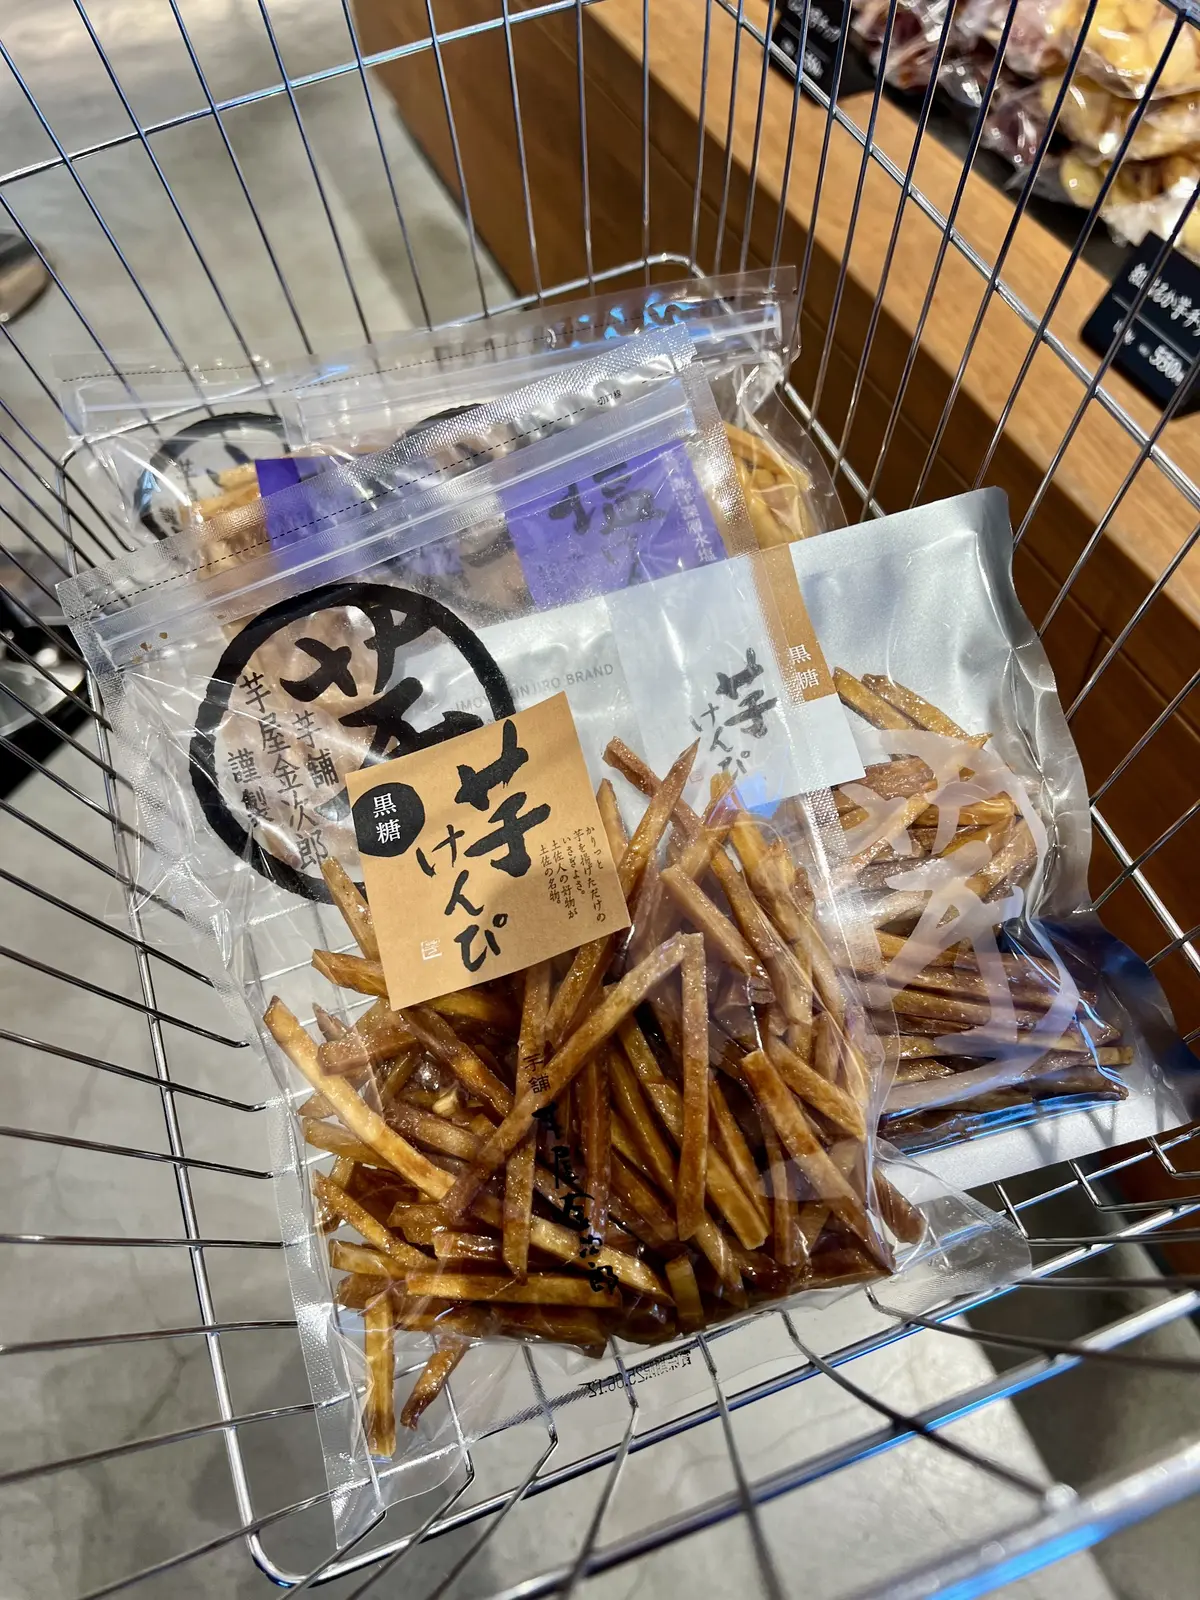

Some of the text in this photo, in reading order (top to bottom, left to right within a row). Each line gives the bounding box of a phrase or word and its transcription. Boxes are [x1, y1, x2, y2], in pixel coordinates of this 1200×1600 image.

[566, 663, 614, 686] BRAND
[789, 644, 820, 690] 黒糖
[227, 747, 275, 828] 謹製
[238, 671, 329, 870] 芋屋金次郎
[373, 792, 402, 844] 黒糖
